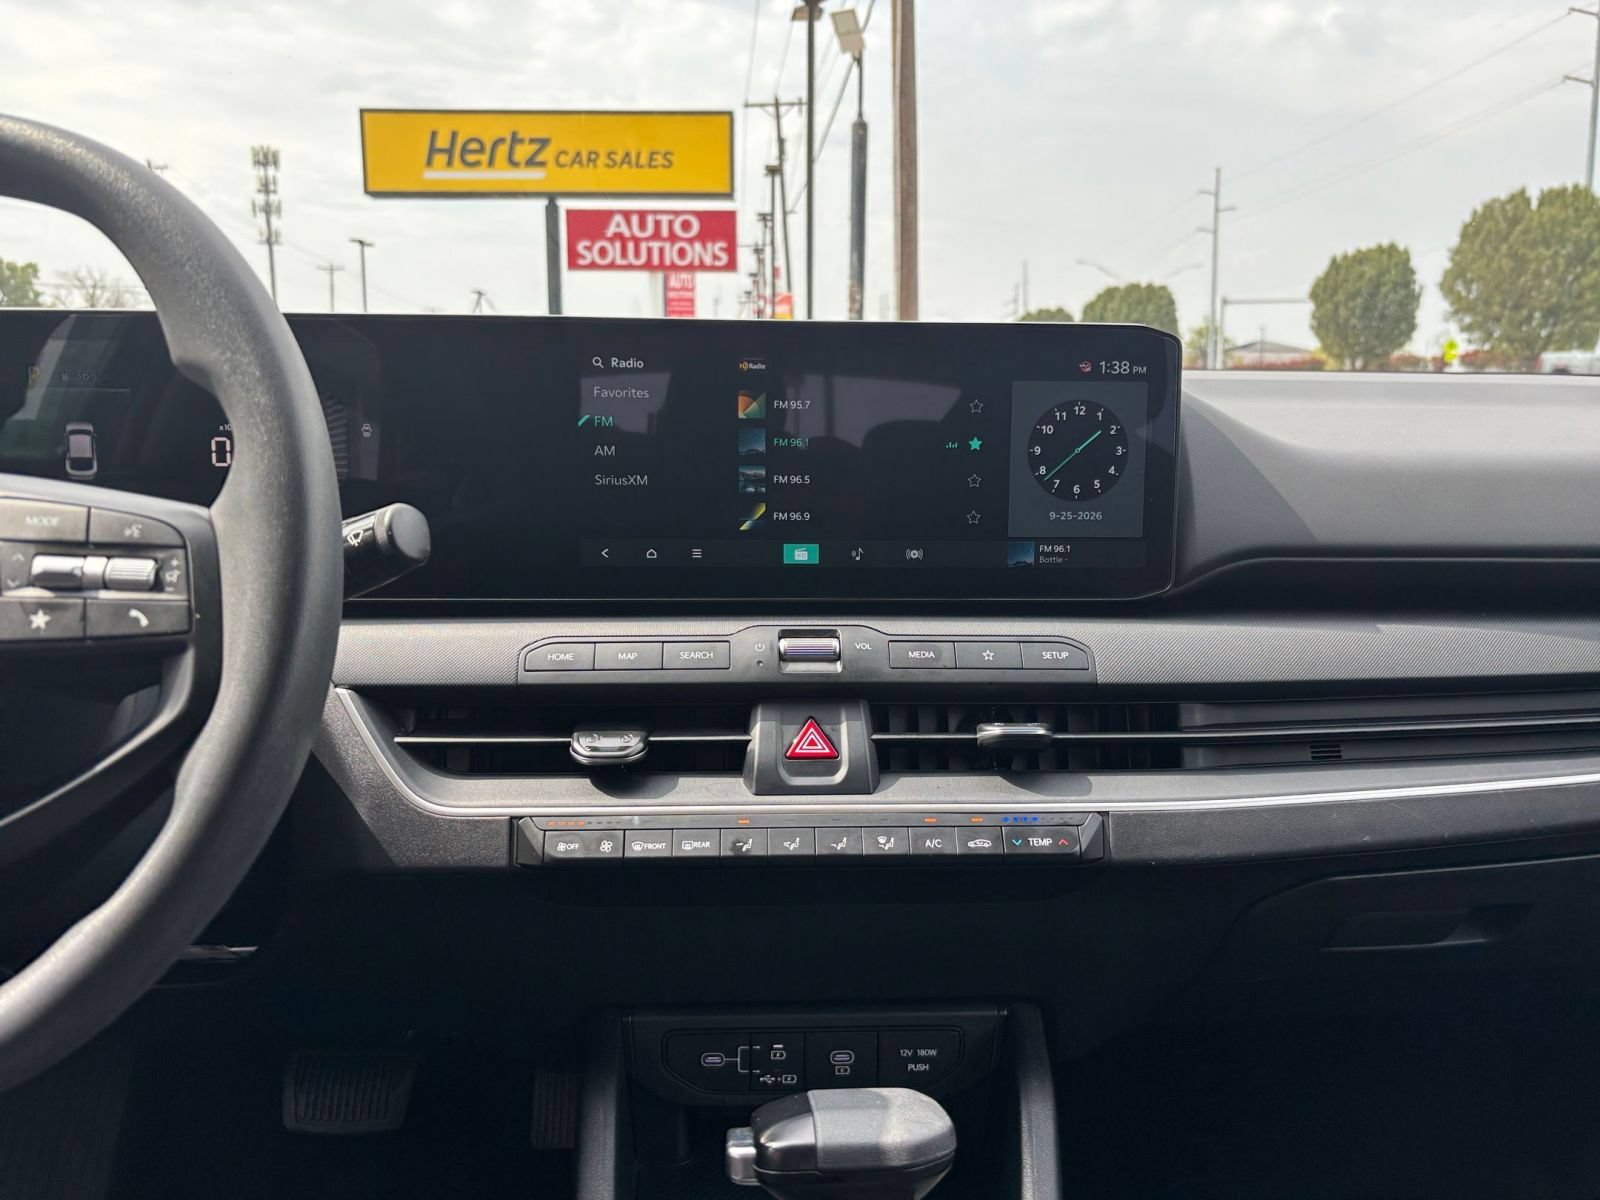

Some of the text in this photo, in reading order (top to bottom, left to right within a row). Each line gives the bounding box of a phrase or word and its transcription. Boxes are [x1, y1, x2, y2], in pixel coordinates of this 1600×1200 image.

[425, 130, 674, 169] Hertz CAR SALES
[606, 214, 700, 239] AUTO
[576, 241, 729, 266] SOLUTIONS
[611, 358, 644, 368] Radio
[1100, 361, 1147, 374] 1:38 PM
[594, 386, 650, 399] Favorites
[773, 400, 811, 409] FM 95.7
[1074, 406, 1086, 415] 12
[1055, 412, 1066, 420] 11
[594, 416, 613, 427] FM
[1041, 425, 1053, 434] 10
[773, 438, 809, 447] FM 96.1
[594, 445, 616, 456] AM
[595, 474, 648, 485] SiriusXM
[773, 475, 810, 484] FM 96.5
[773, 512, 810, 521] FM 96.9
[1049, 511, 1103, 521] 9-25-2026
[25, 516, 60, 527] MODE
[1039, 545, 1071, 553] FM 96.1
[1039, 556, 1063, 564] Bottle
[548, 653, 575, 661] HOME
[618, 652, 638, 660] MAP
[680, 651, 713, 659] SEARCH
[909, 651, 935, 659] MEDIA
[1042, 651, 1069, 660] SETUP
[925, 839, 942, 848] A/C
[1028, 837, 1052, 846] TEMP
[900, 1048, 937, 1057] 12V 180W
[908, 1063, 929, 1072] PUSH
